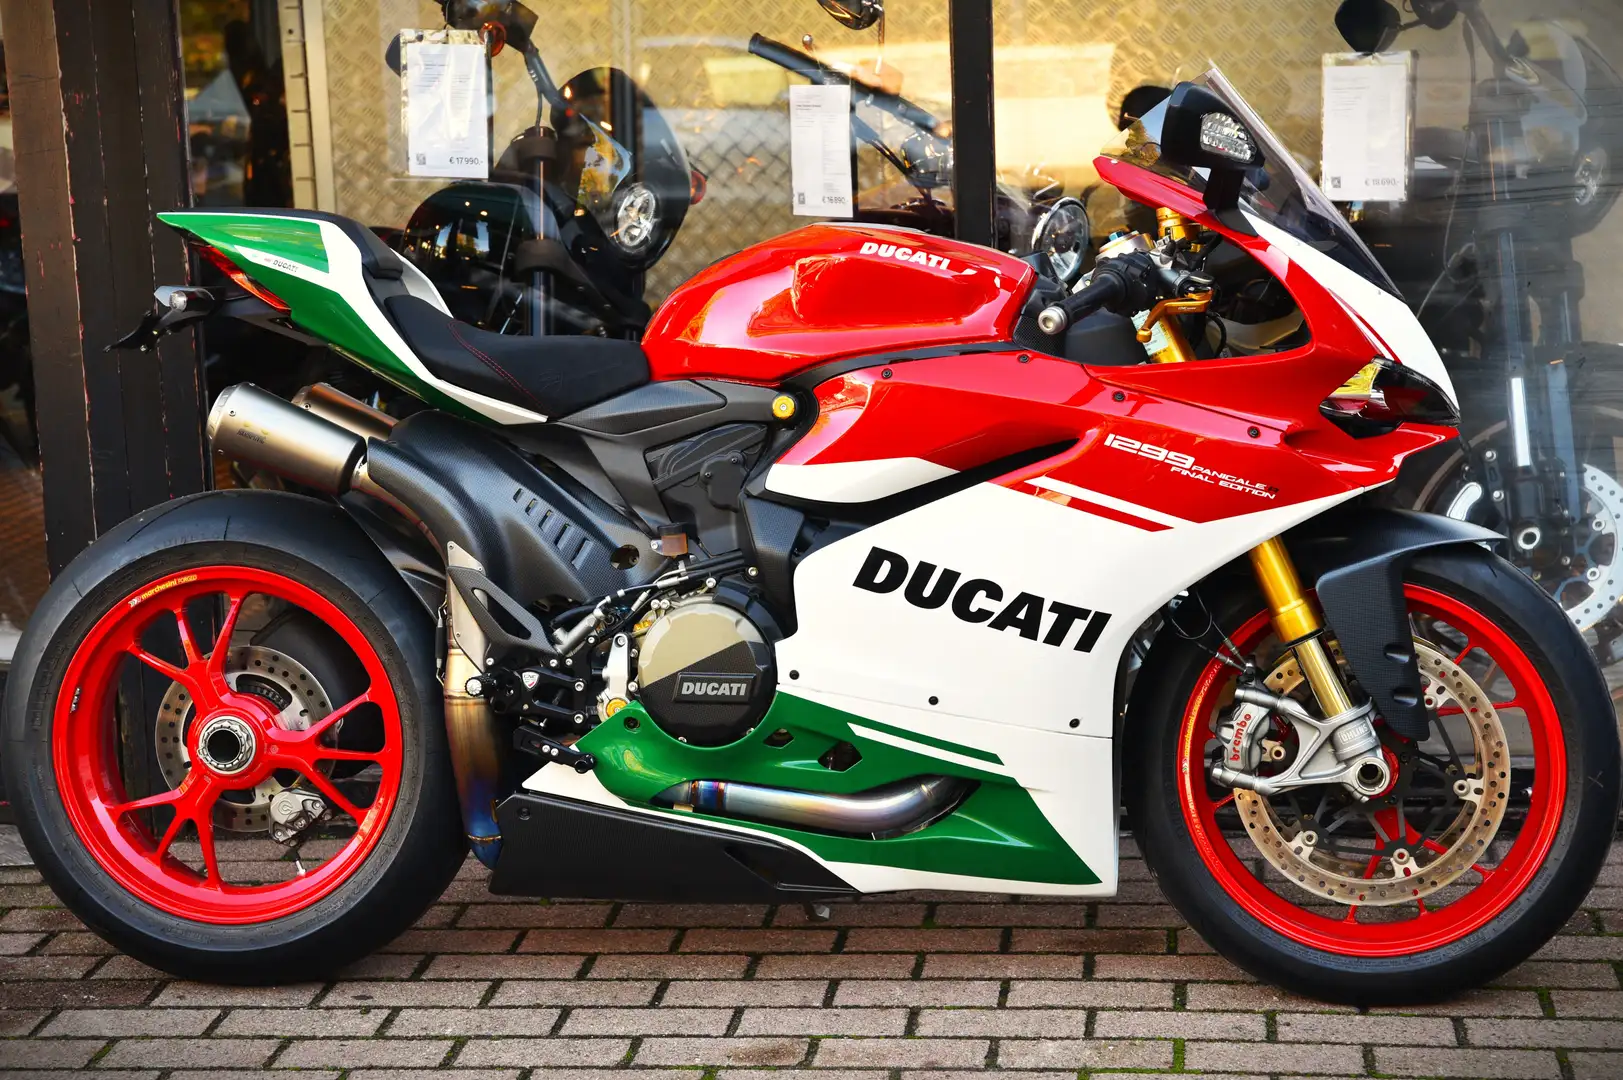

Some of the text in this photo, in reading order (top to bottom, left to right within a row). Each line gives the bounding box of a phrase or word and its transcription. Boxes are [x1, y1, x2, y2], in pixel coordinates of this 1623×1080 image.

[272, 260, 299, 273] DUCATI
[860, 242, 951, 270] DUCATI
[1104, 433, 1195, 469] 1299
[1191, 465, 1267, 490] PANIGALE
[1170, 466, 1276, 500] FINAL EDITION
[141, 578, 178, 600] marchesini
[852, 546, 1113, 654] DUCATI
[681, 682, 747, 695] DUCATI
[1230, 713, 1252, 761] brembo
